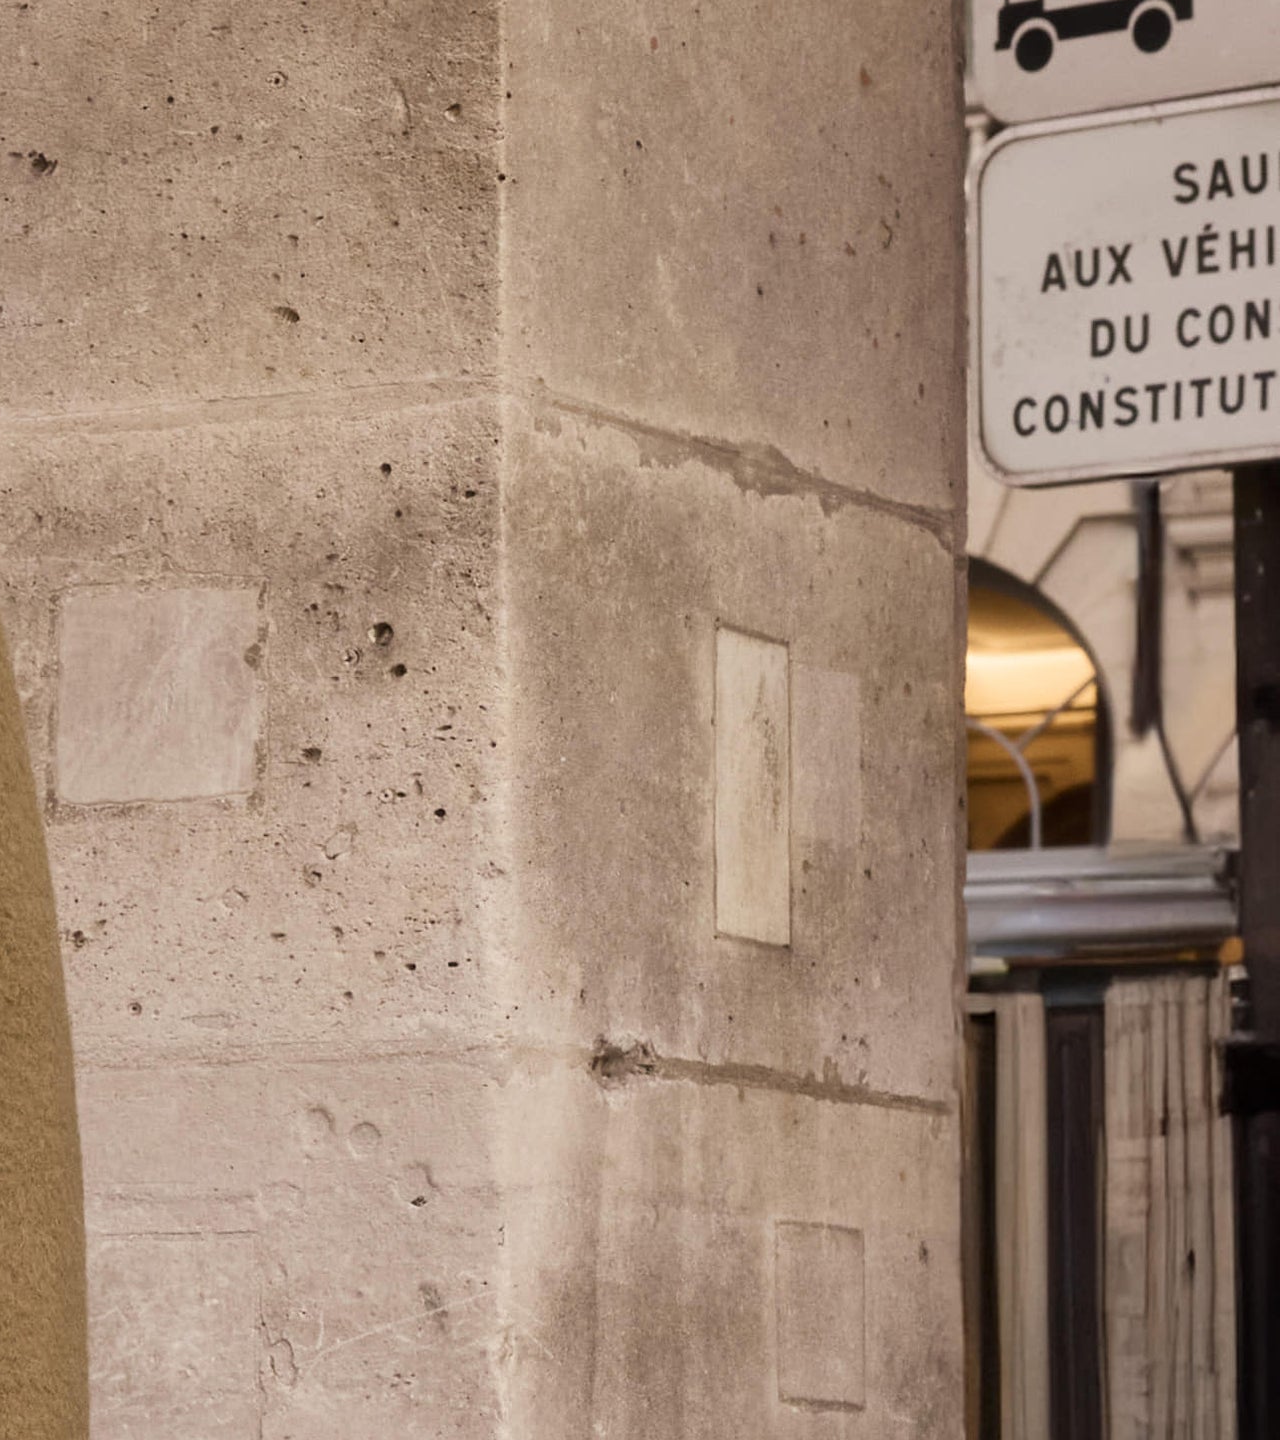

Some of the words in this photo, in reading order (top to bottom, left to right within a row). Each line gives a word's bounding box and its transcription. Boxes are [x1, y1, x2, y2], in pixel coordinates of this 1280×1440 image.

[1173, 151, 1280, 205] SAU
[1041, 243, 1133, 293] AUX
[1161, 223, 1275, 278] VÉHI
[1090, 313, 1150, 358] DU
[1176, 298, 1280, 349] CON
[1013, 370, 1277, 438] CONSTITUT
